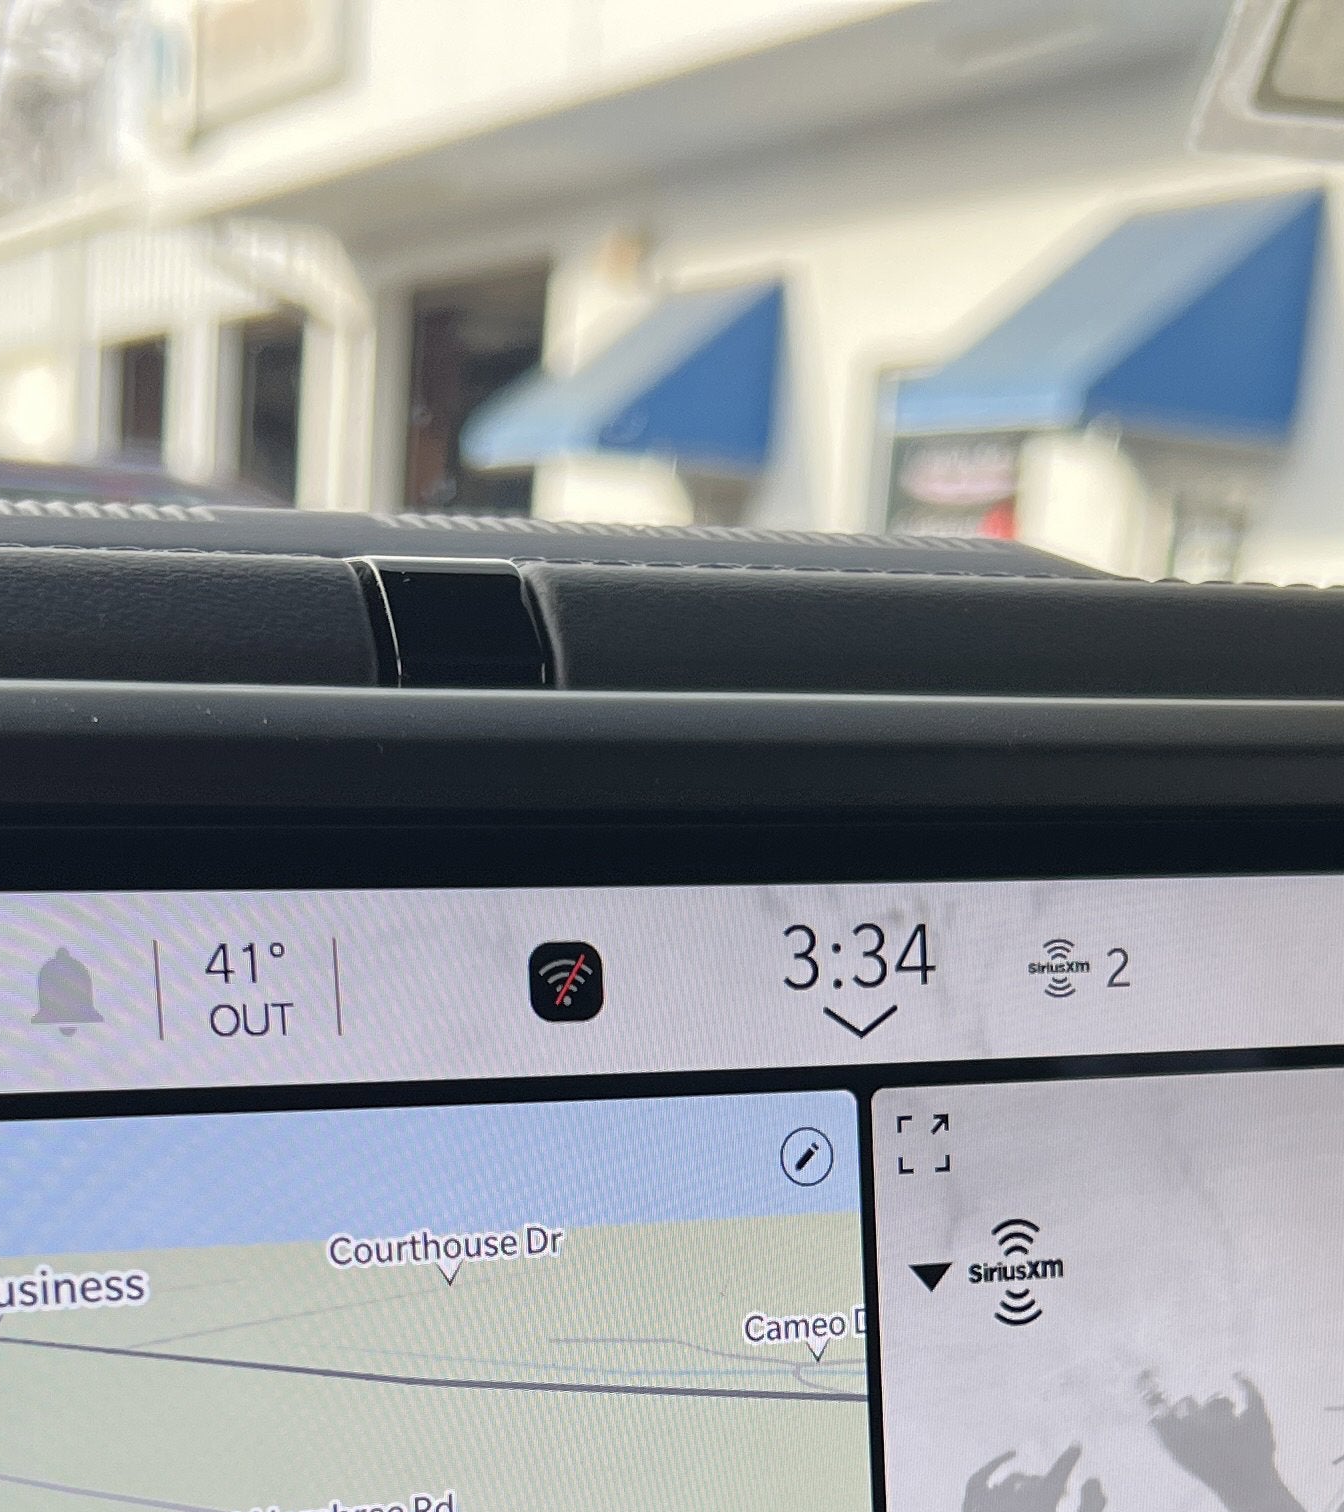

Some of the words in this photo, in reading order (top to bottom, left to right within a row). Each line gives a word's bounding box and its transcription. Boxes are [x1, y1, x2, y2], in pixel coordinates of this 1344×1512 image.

[205, 941, 286, 984] 41°
[782, 922, 936, 989] 3:34
[1106, 947, 1131, 987] 2
[209, 1002, 294, 1036] OUT
[328, 1231, 519, 1267] Courthouse
[526, 1226, 565, 1255] Dr
[744, 1315, 846, 1342] Cameo
